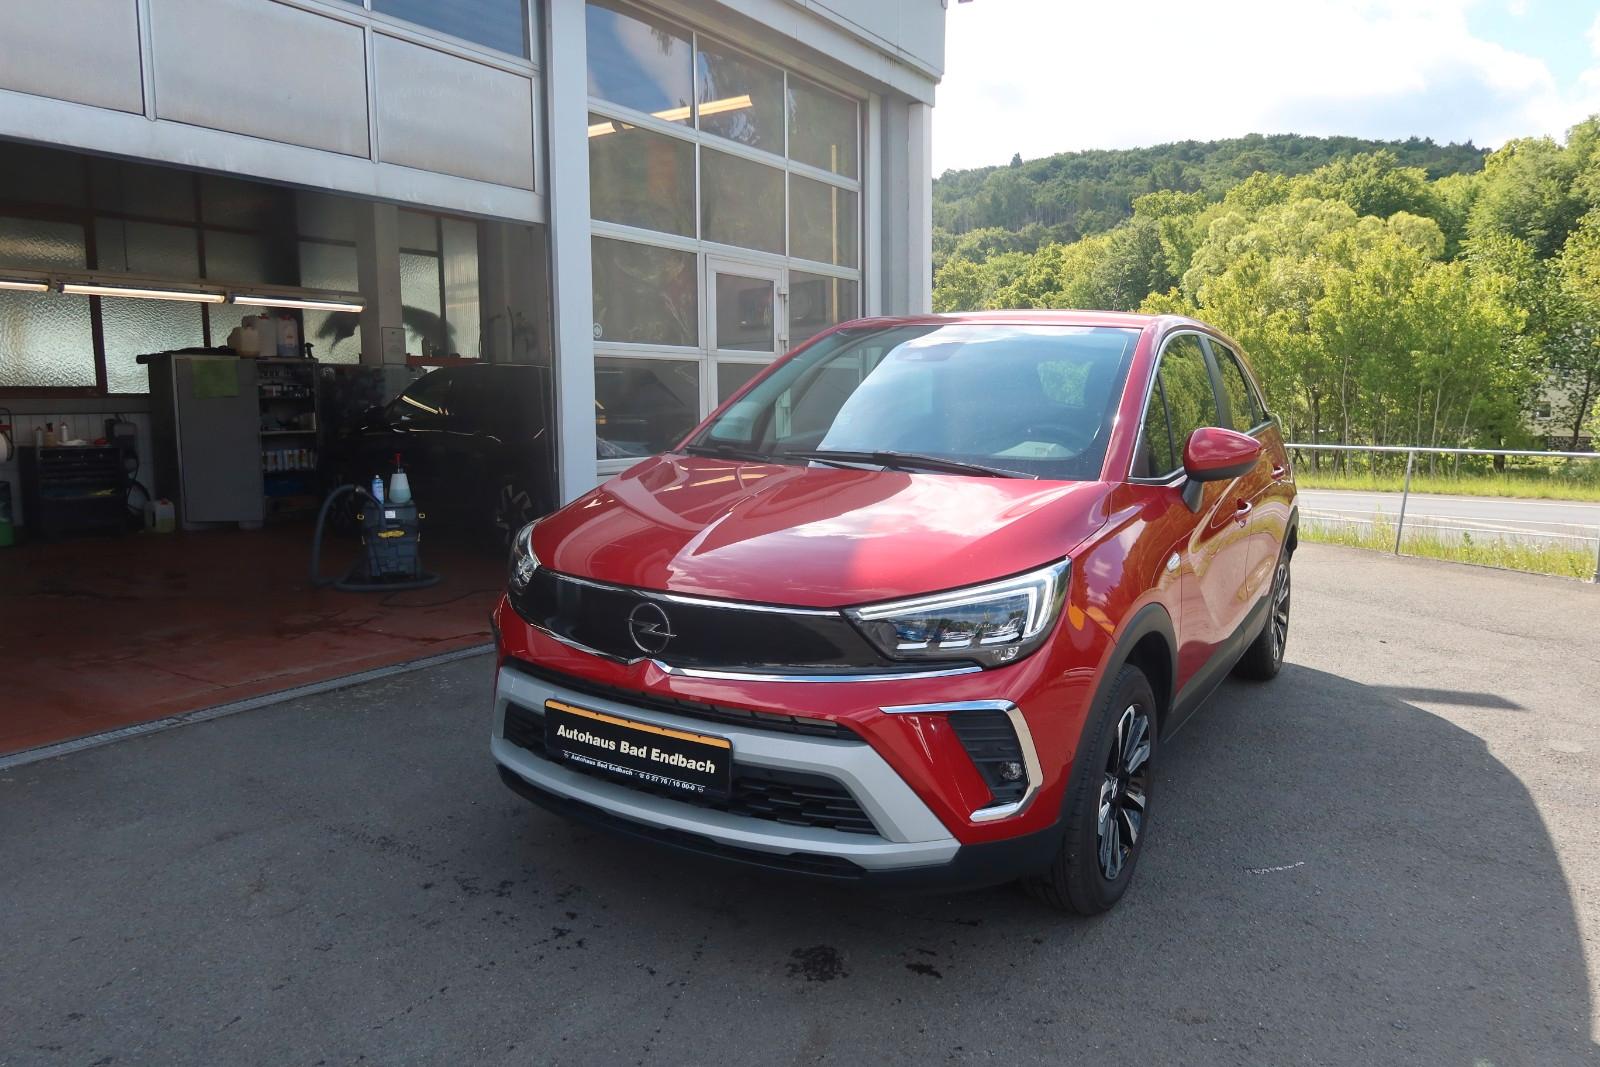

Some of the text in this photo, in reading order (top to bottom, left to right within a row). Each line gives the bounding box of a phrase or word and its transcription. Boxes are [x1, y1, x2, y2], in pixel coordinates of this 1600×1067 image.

[557, 724, 716, 774] Autohaus Bad Endbach
[571, 754, 596, 766] Autohaus
[597, 761, 608, 769] Bad
[609, 764, 633, 776] Endbach
